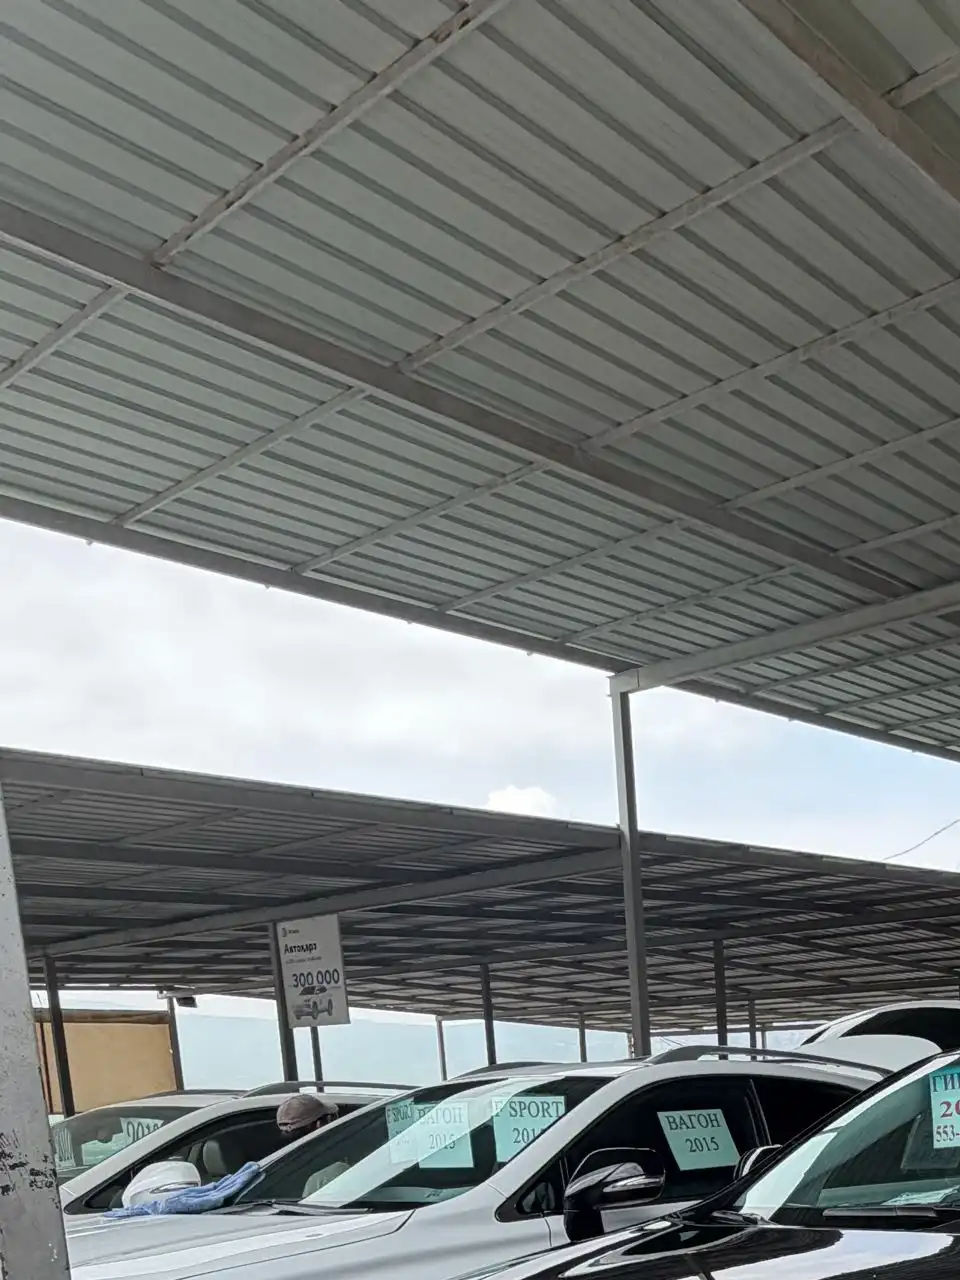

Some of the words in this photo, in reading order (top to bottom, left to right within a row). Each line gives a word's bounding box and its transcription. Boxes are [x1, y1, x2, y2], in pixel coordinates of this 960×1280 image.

[292, 971, 314, 988] 300
[316, 968, 340, 985] 000
[508, 1100, 564, 1118] SPORT
[664, 1113, 722, 1131] ВАГОН
[685, 1136, 720, 1153] 2015
